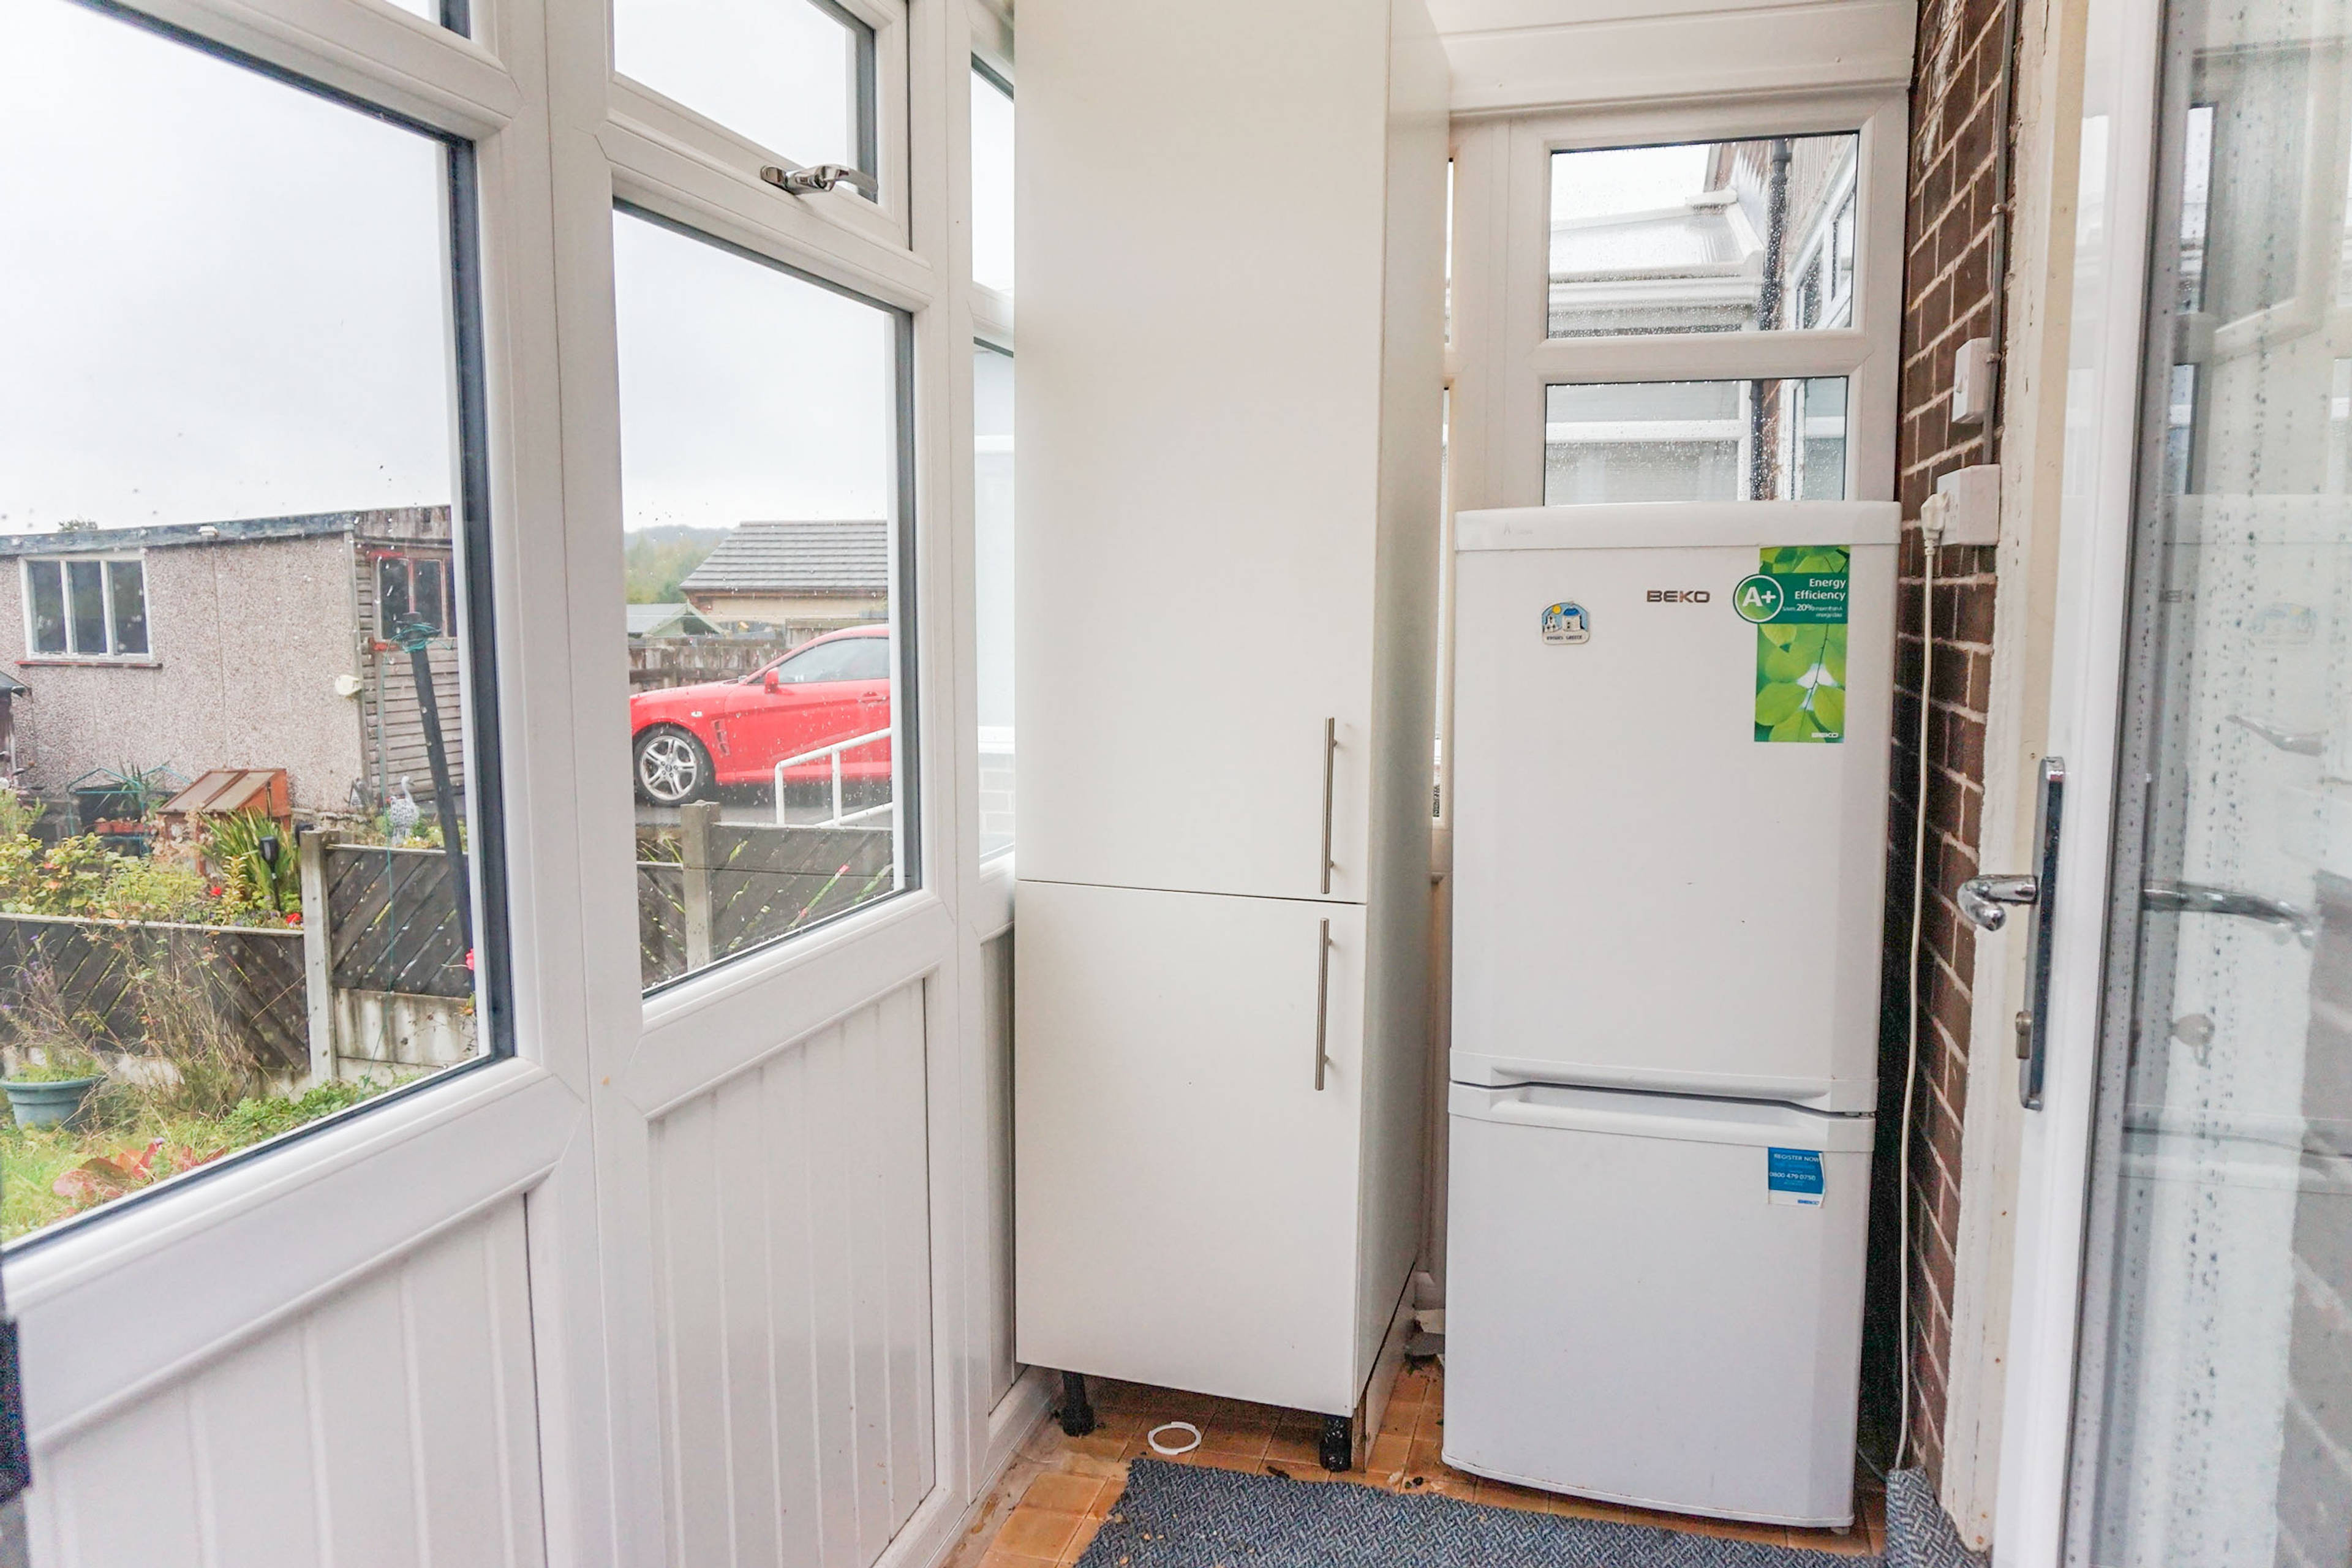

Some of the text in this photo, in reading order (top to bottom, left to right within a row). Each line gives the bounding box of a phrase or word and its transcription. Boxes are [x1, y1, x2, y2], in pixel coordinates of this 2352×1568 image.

[1809, 578, 1846, 589] Energy
[1646, 590, 1710, 603] BEKO
[1741, 586, 1777, 607] A+
[1794, 590, 1846, 601] Efficiency
